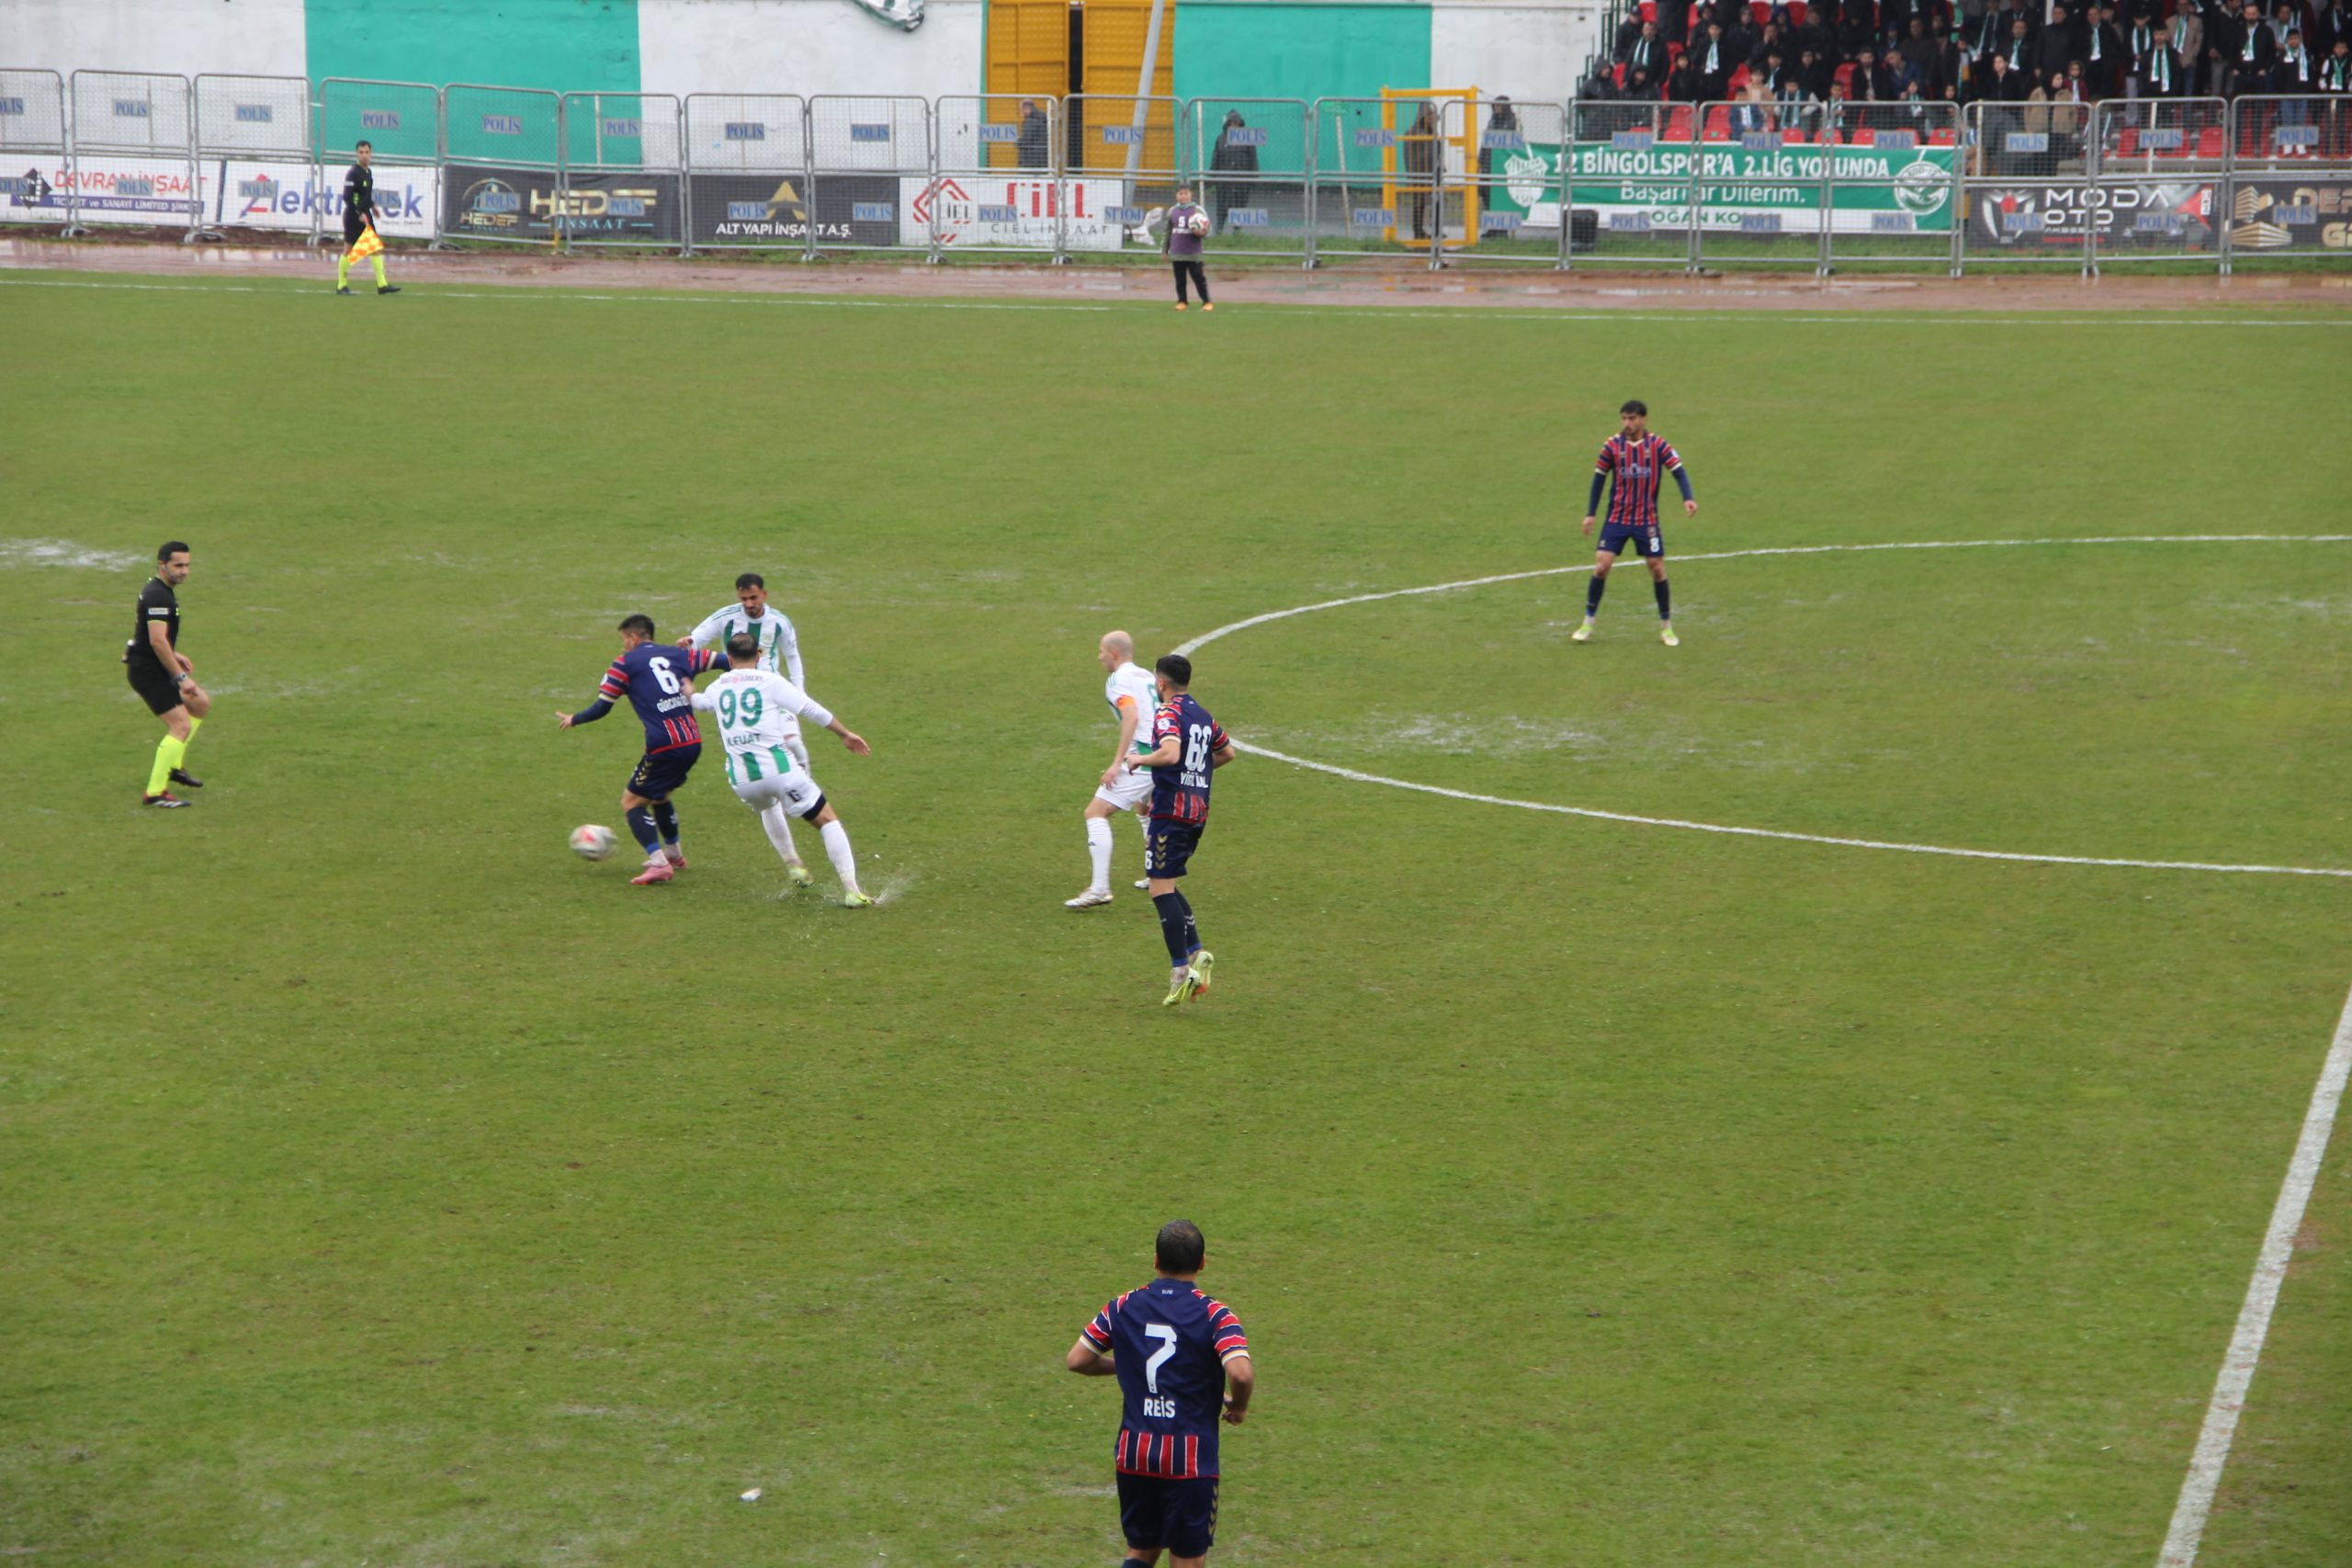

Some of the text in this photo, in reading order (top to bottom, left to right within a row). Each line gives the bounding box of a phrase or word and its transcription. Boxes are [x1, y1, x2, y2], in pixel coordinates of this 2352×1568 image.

[372, 190, 400, 208] OLİS
[1620, 180, 1717, 206] Başarıar
[2045, 187, 2171, 209] MODA
[716, 223, 740, 235] ALT
[742, 223, 773, 235] YAPI
[1649, 537, 1661, 553] 8
[648, 656, 681, 695] 6
[718, 686, 763, 730] 99
[1145, 1323, 1178, 1394] 7
[1143, 1395, 1177, 1419] REİS
